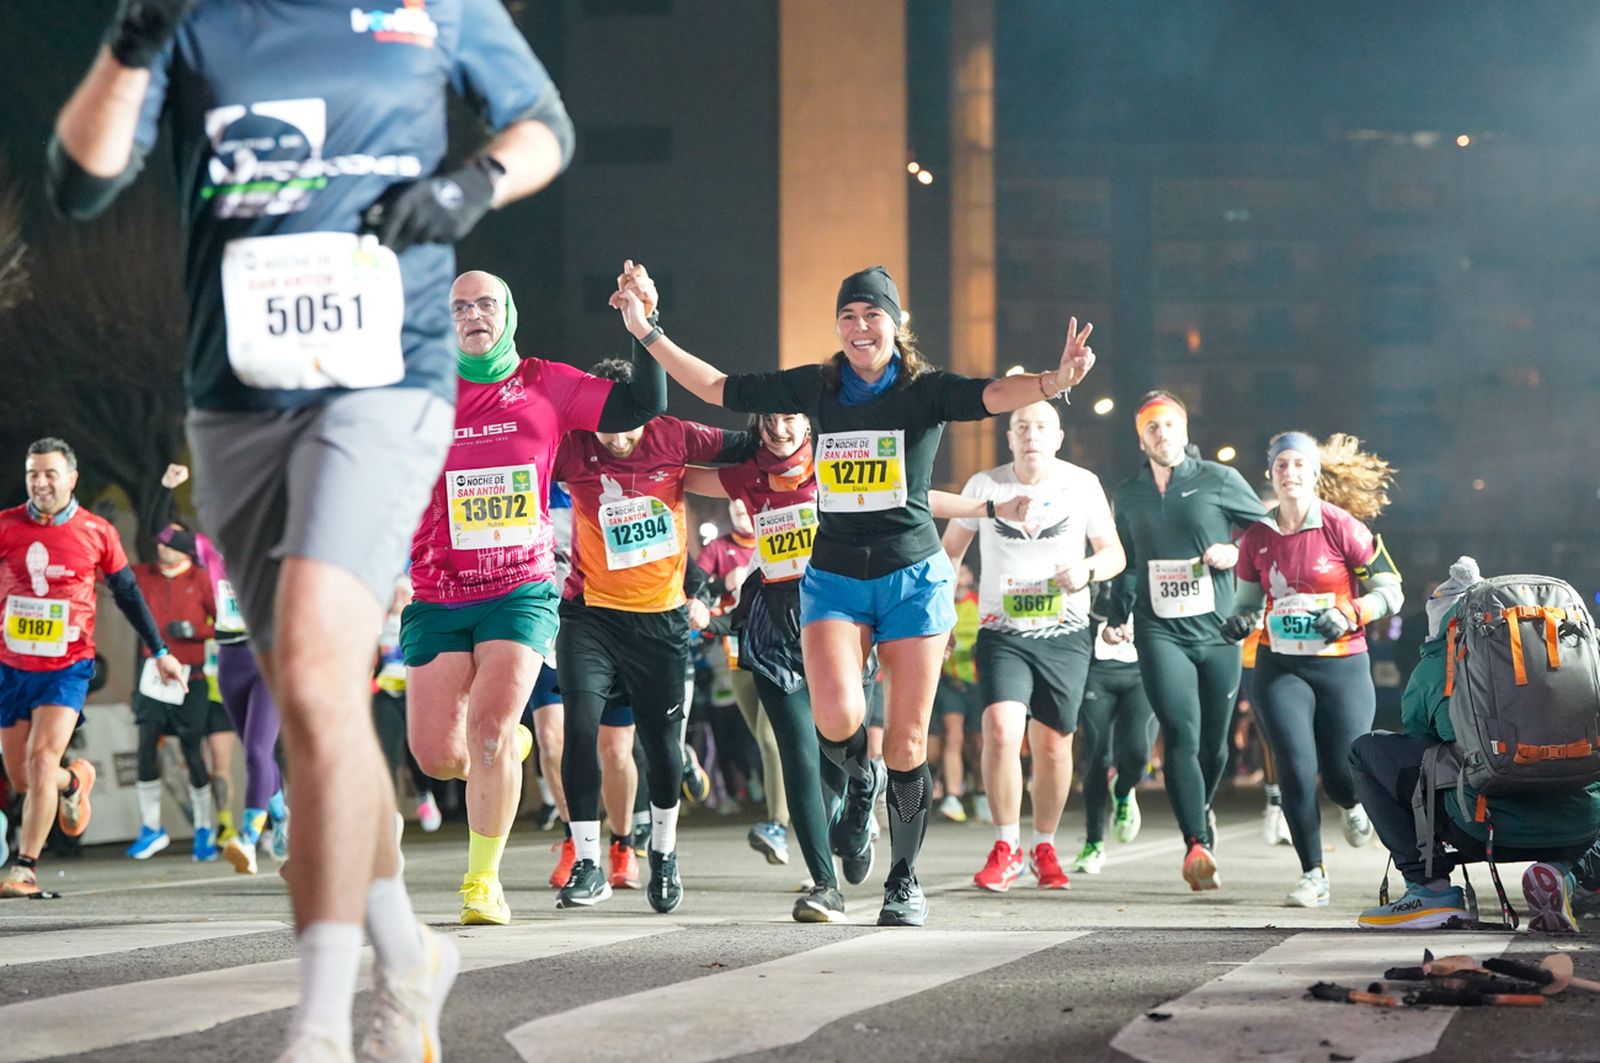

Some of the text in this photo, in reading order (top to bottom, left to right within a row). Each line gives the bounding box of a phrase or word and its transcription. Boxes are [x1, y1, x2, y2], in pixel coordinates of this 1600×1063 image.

[266, 293, 363, 336] 5051
[453, 421, 518, 439] OLISS
[834, 440, 870, 449] NOCHE DE
[824, 450, 841, 460] SAN
[467, 477, 494, 486] NOCHE
[494, 475, 505, 484] DE
[830, 460, 888, 484] 12777
[457, 488, 475, 497] SAN
[461, 494, 528, 522] 13672
[614, 504, 646, 516] NOCHE DE
[608, 517, 623, 526] SAN
[766, 516, 785, 526] NOCHE
[786, 513, 794, 521] DE
[611, 515, 667, 546] 12394
[761, 526, 774, 535] SAN
[766, 528, 812, 556] 12217
[1160, 580, 1201, 598] 3399
[1013, 594, 1054, 612] 3667
[18, 617, 53, 636] 9187
[1282, 615, 1313, 634] 957
[1391, 899, 1423, 913] HOKA
